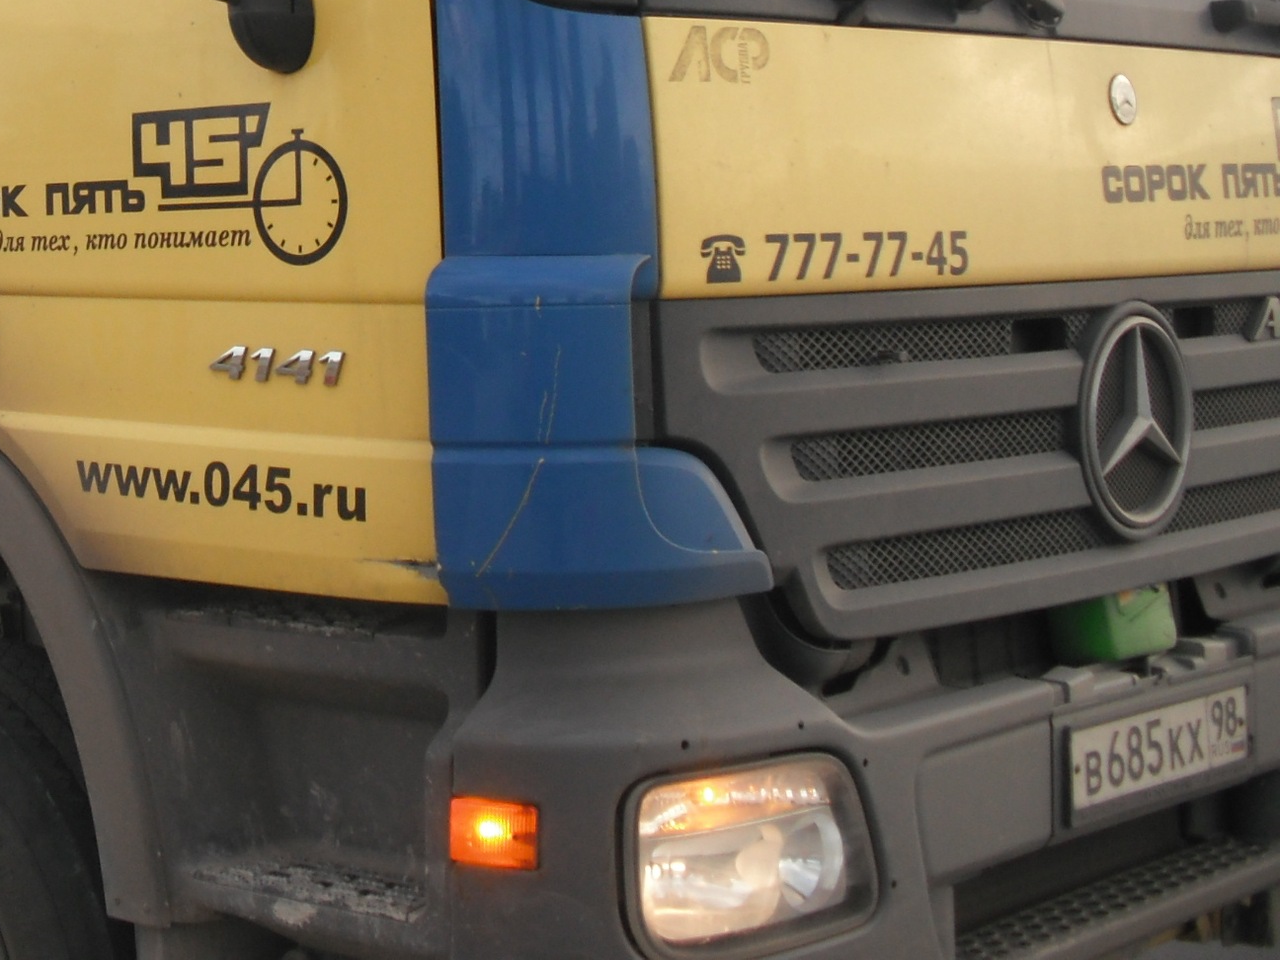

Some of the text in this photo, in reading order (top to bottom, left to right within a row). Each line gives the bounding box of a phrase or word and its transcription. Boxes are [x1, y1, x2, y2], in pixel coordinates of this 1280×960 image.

[45, 179, 146, 216] ПЯТЬ
[1101, 163, 1211, 204] СОРОК
[86, 233, 128, 252] кто
[134, 226, 252, 250] понимает
[1184, 213, 1210, 241] для
[764, 230, 969, 282] 777-77-45
[208, 344, 347, 387] 4141
[76, 459, 368, 523] www.045.ru
[1211, 696, 1237, 741] 98
